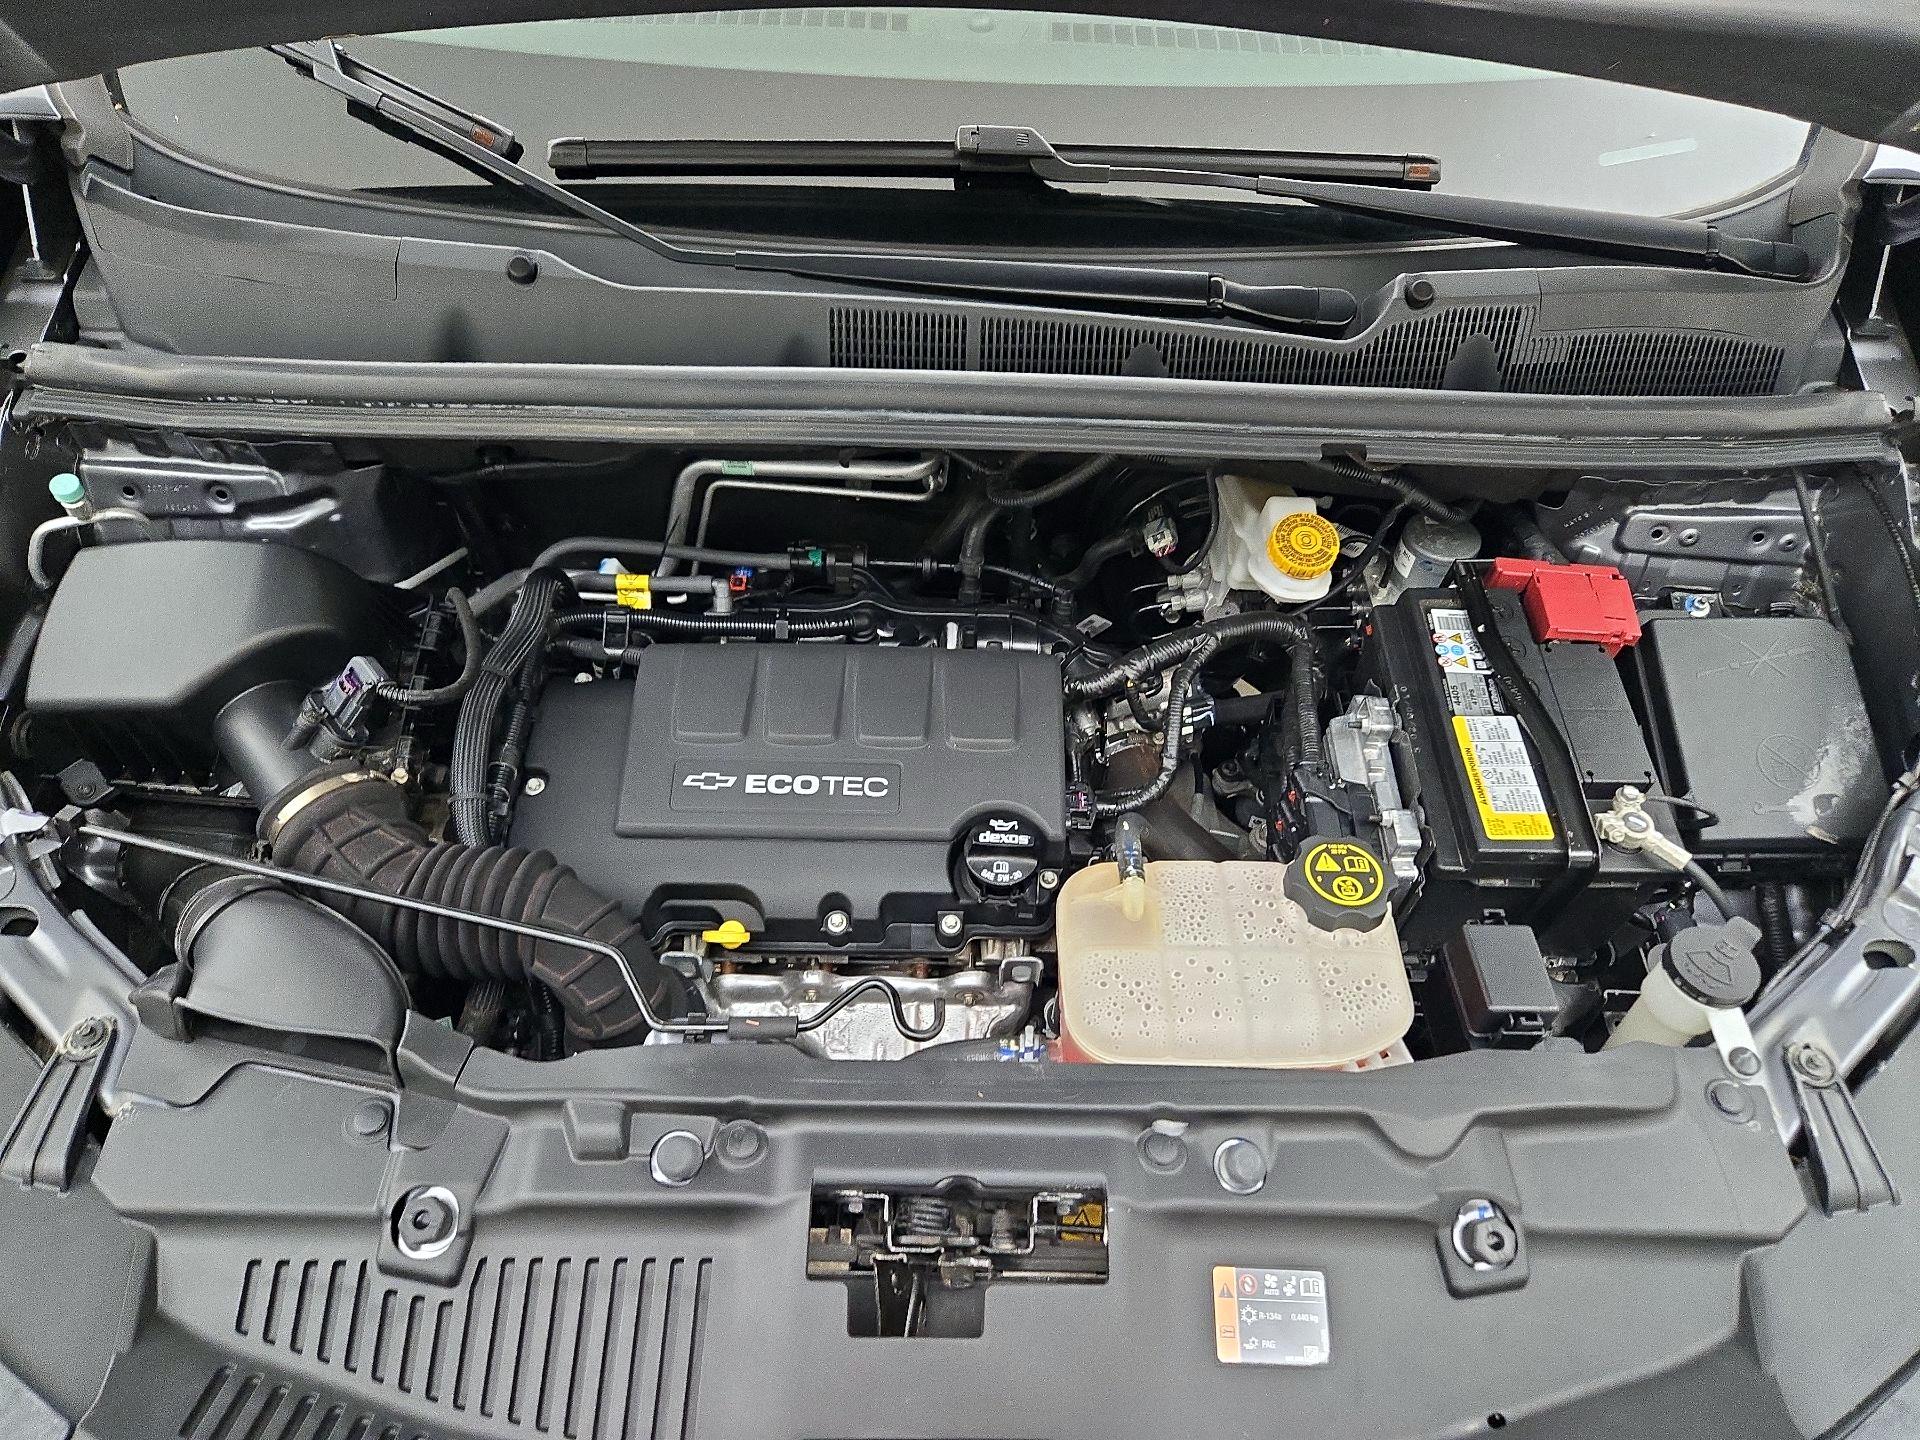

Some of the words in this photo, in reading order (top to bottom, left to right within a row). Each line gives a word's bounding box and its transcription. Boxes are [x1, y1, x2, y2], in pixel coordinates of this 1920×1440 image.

[1451, 685, 1462, 706] 4405
[745, 774, 889, 797] ECOTEC
[978, 830, 1029, 845] dexos
[1261, 1339, 1276, 1349] PAG
